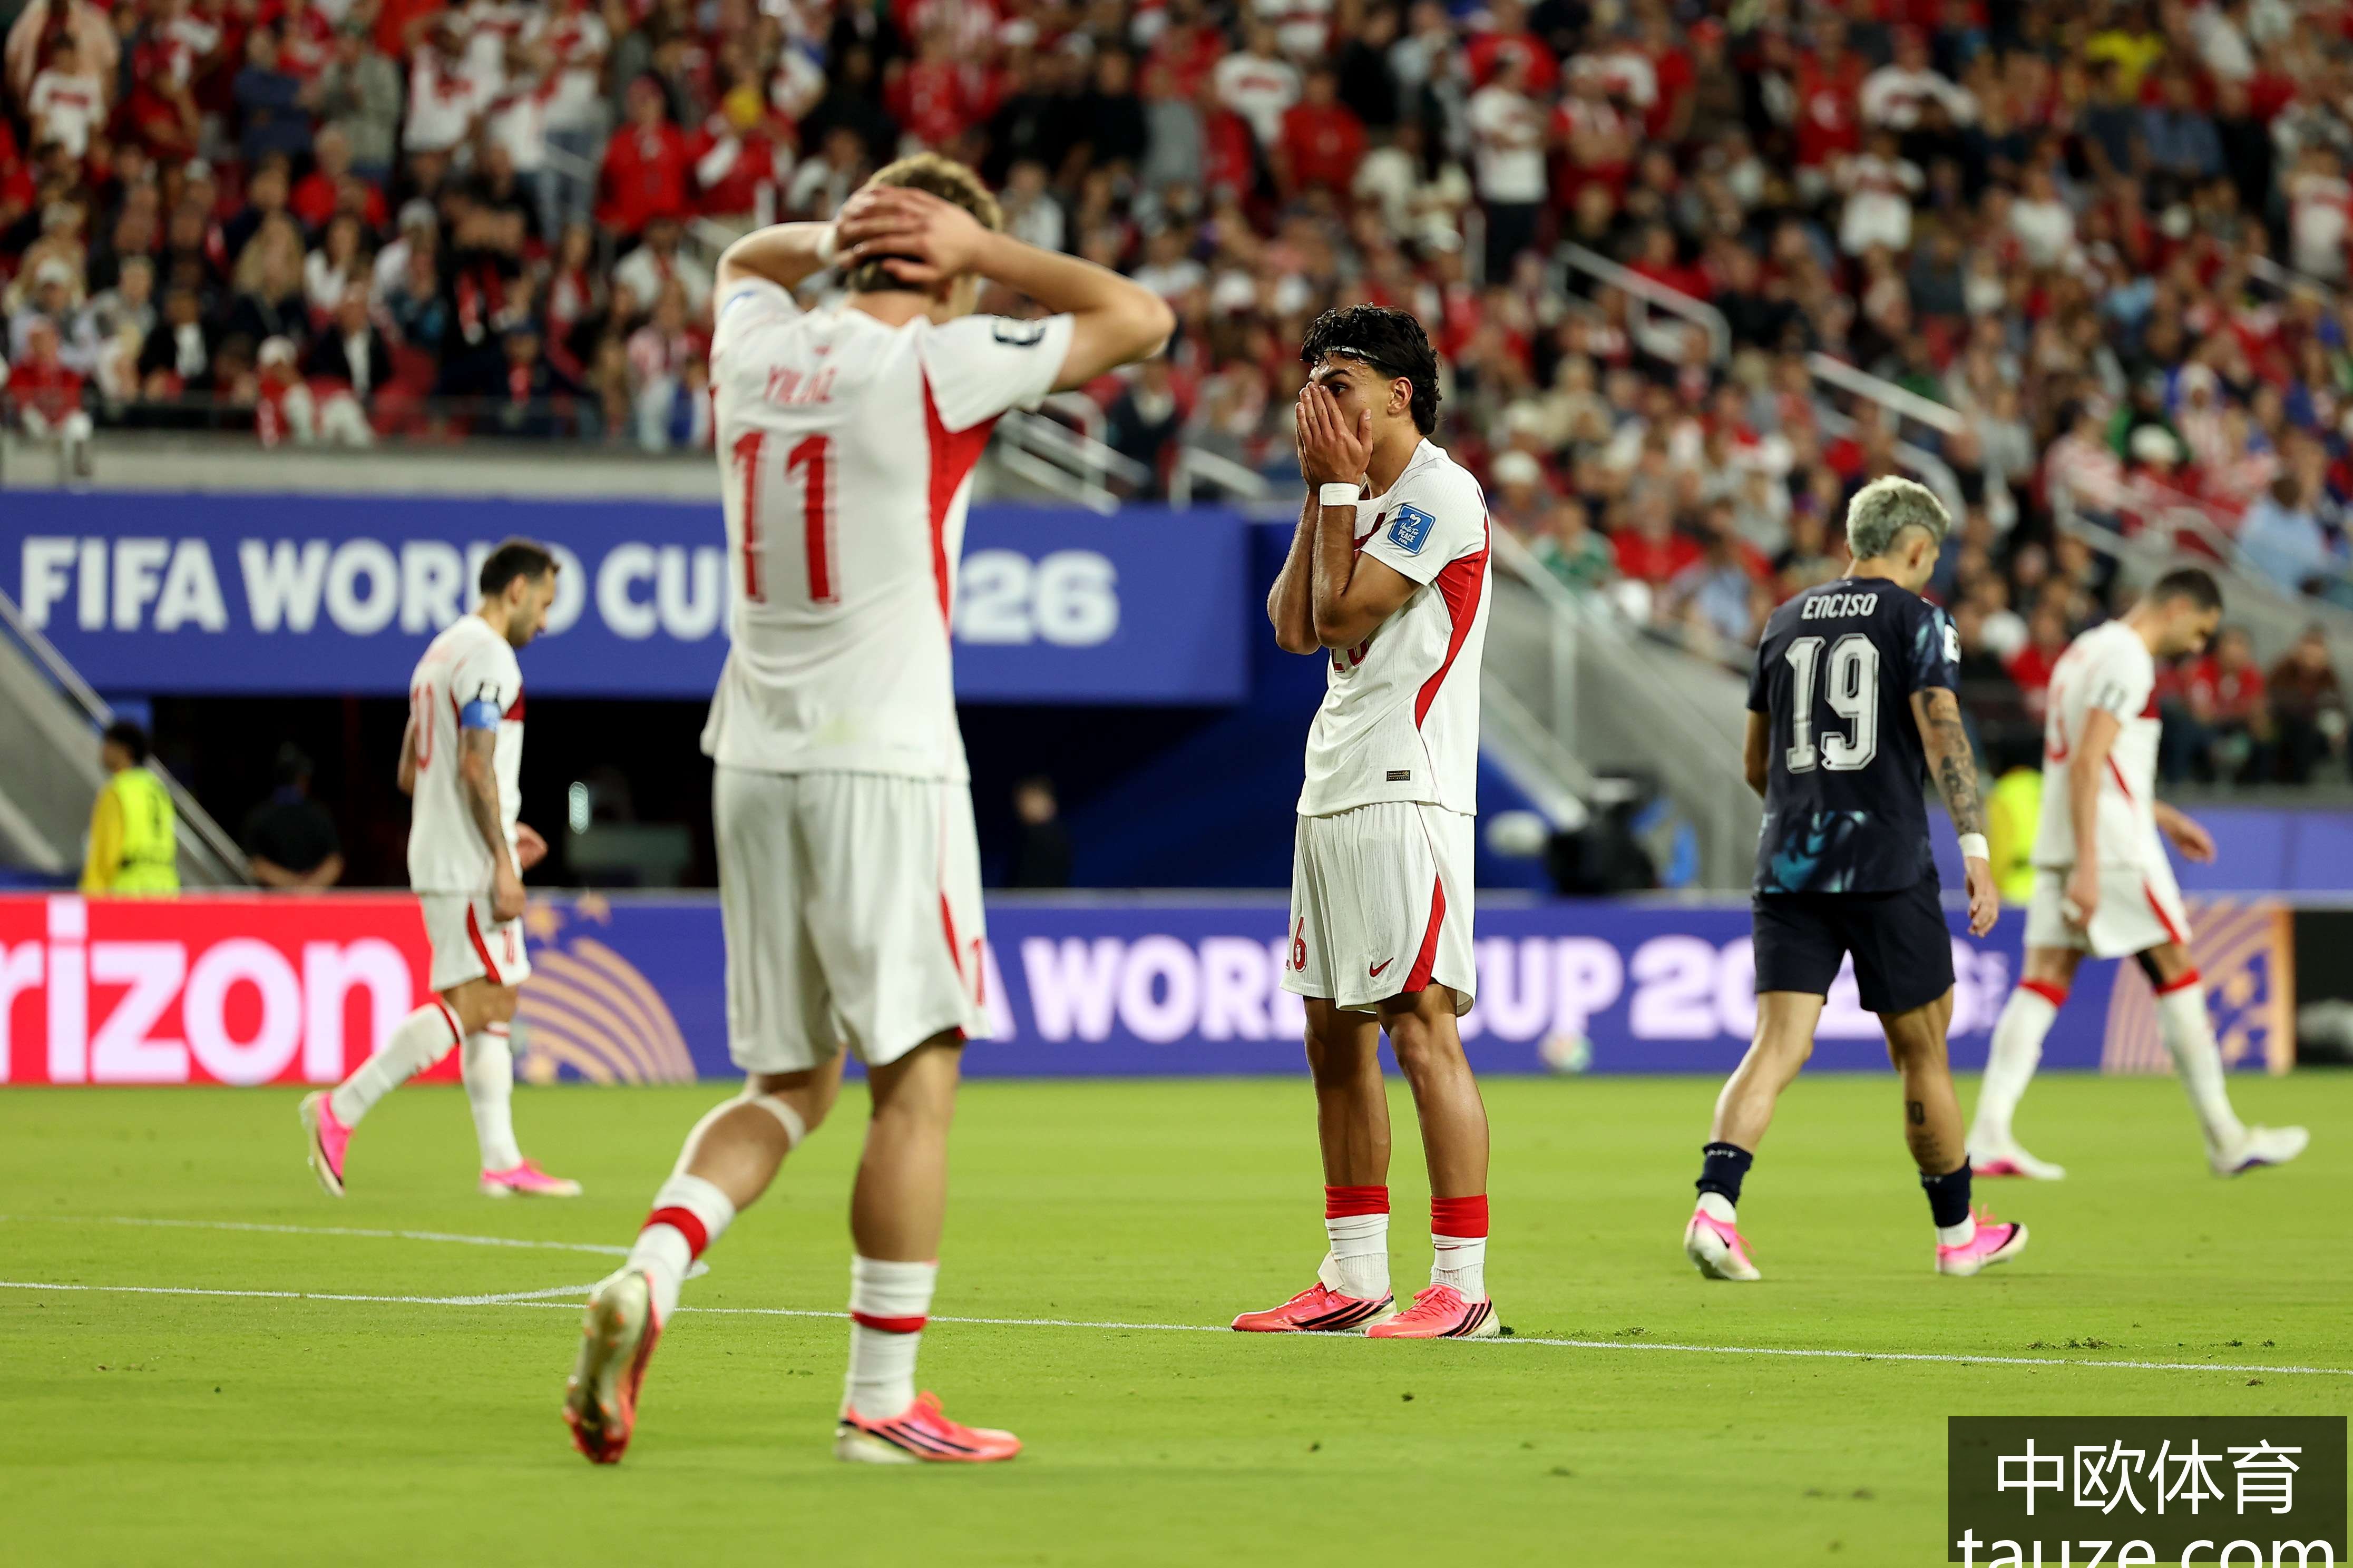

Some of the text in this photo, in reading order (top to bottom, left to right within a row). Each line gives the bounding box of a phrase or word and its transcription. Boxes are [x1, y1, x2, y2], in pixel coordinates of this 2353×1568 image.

[733, 432, 839, 604] 11
[1398, 530, 1416, 543] PEACE
[22, 536, 229, 632] FIFA
[595, 542, 733, 641] CU
[1801, 593, 1879, 620] ENCISO
[1785, 633, 1880, 774] 19
[1286, 916, 1307, 973] 6
